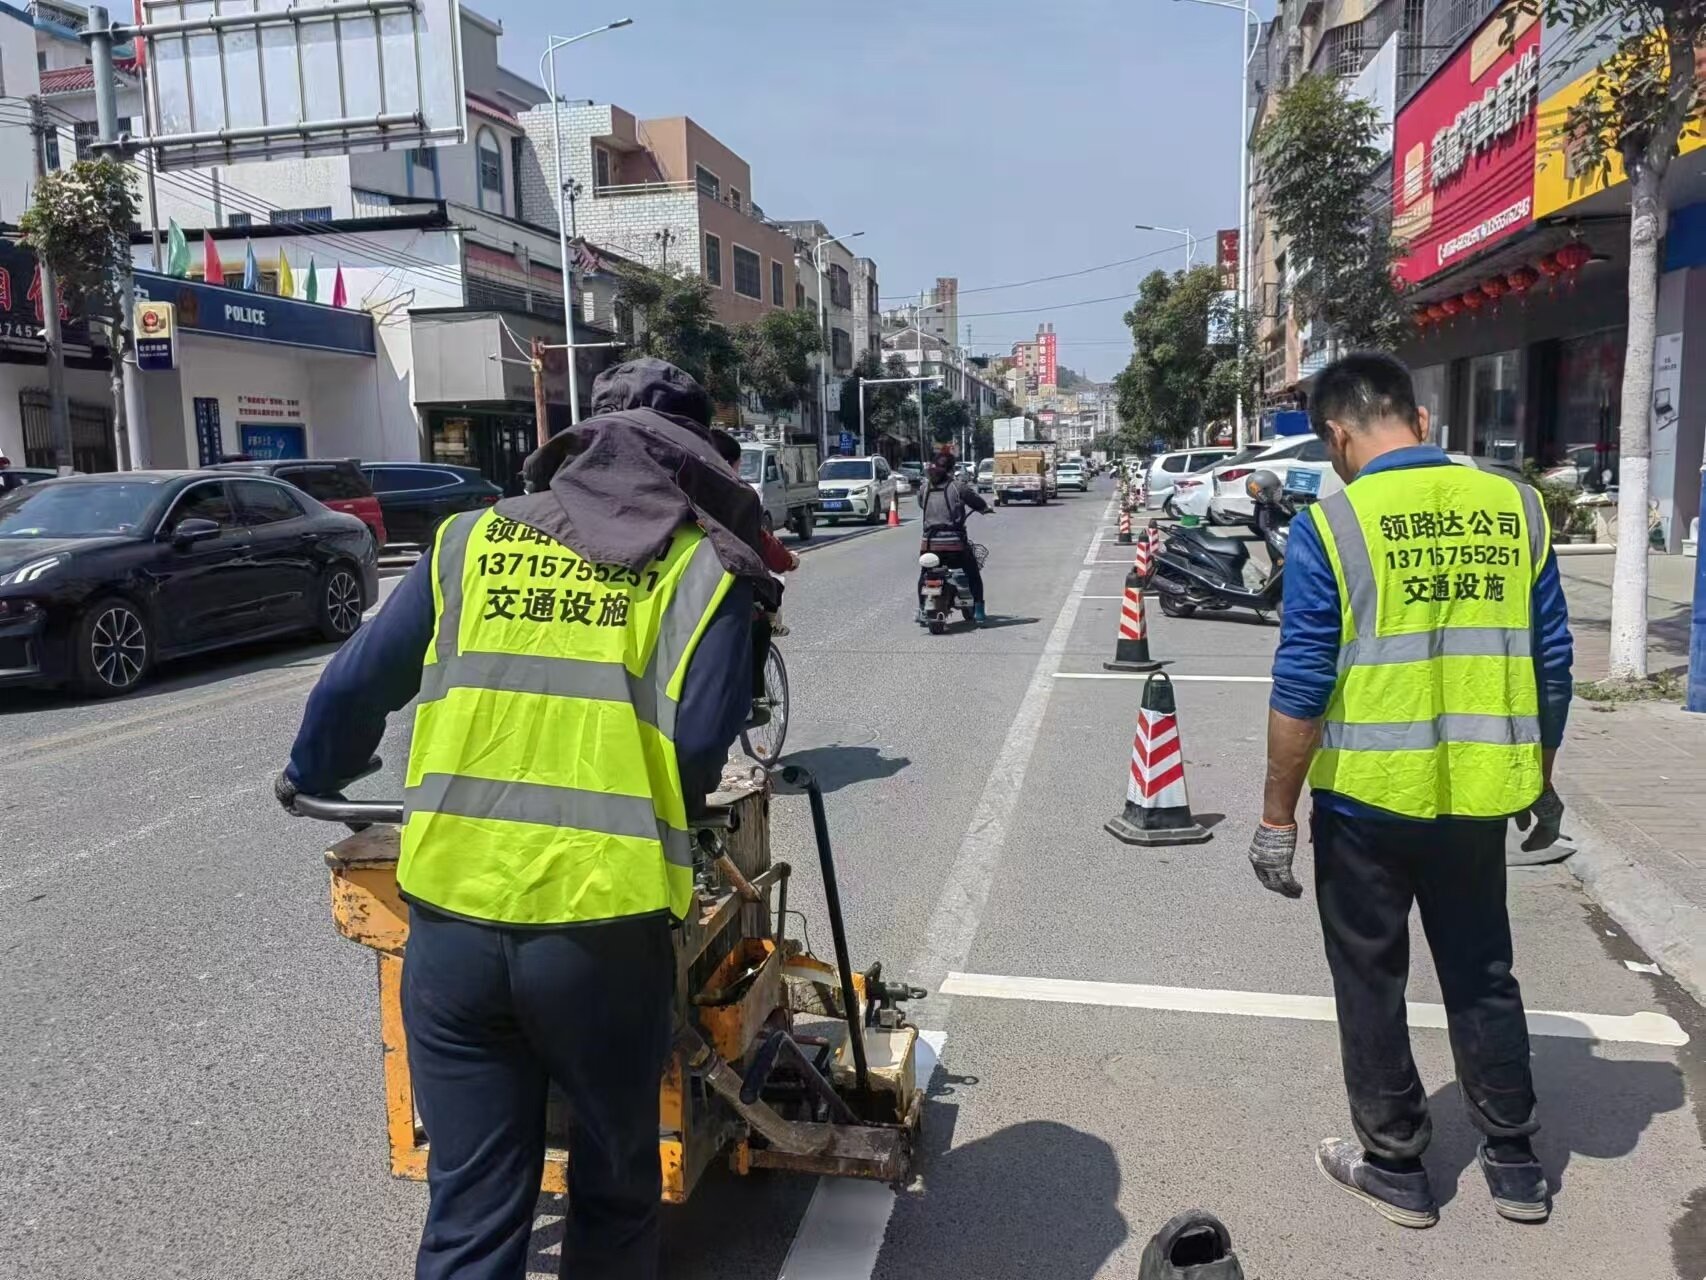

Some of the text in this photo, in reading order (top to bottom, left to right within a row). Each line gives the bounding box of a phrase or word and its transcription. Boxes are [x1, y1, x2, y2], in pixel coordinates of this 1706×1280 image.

[224, 304, 266, 325] POLICE
[1379, 509, 1521, 542] 领路达公司
[1386, 545, 1520, 570] 13715755251
[1402, 572, 1506, 606] 交通设施
[484, 585, 631, 627] 交通设施
